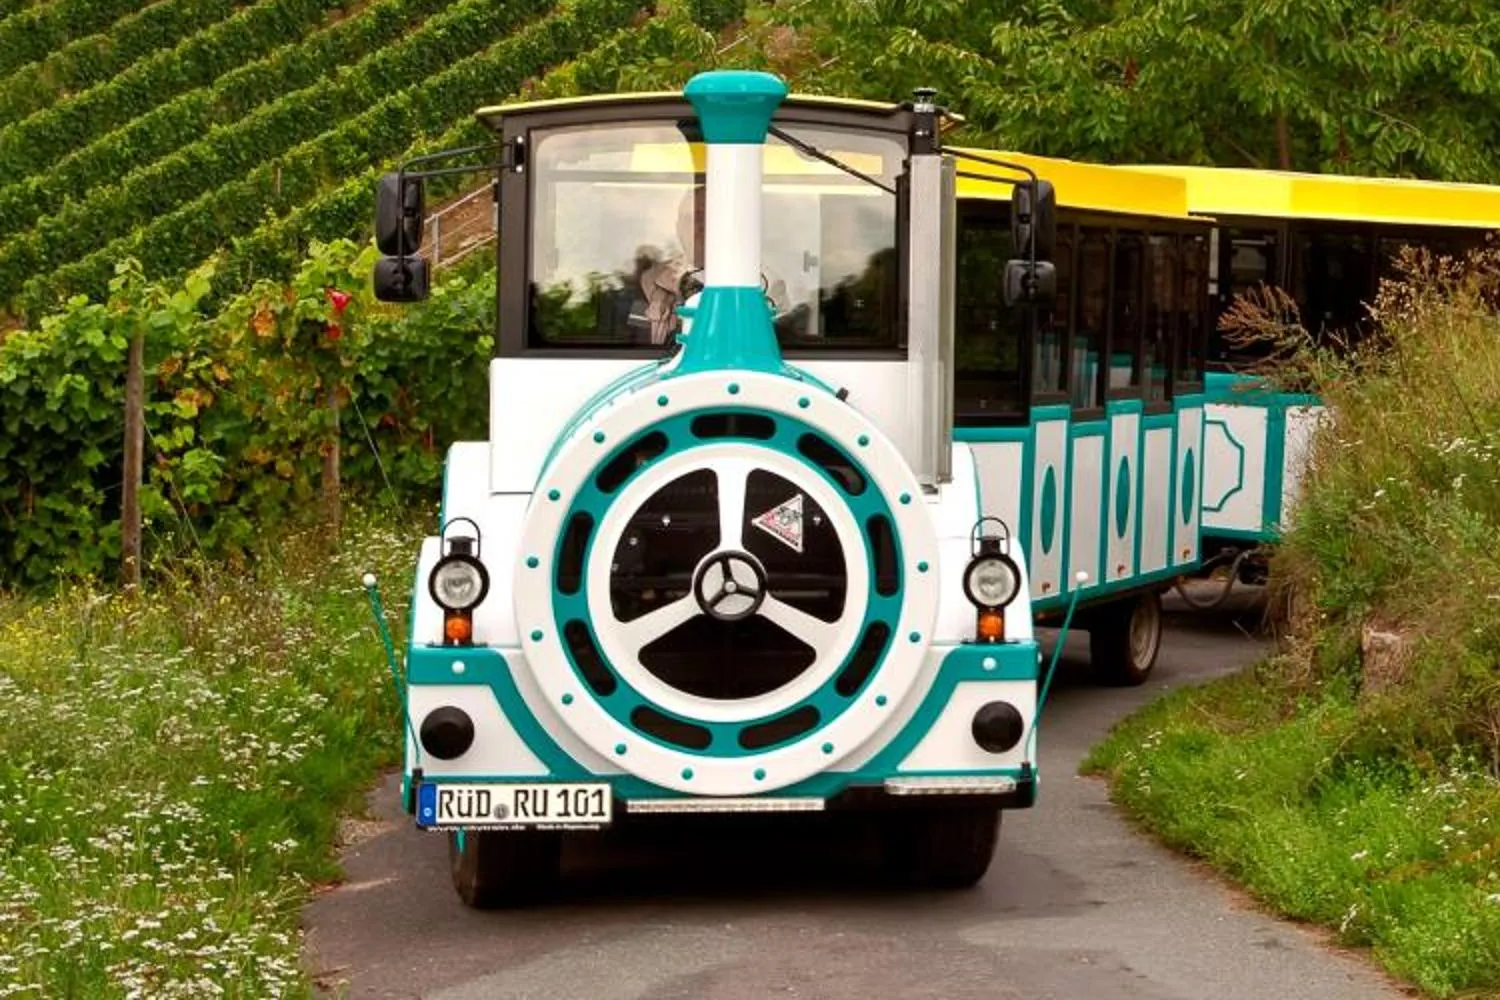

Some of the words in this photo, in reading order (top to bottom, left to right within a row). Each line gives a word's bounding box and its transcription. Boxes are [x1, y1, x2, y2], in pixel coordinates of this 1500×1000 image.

[438, 789, 492, 818] RÜD
[514, 789, 549, 818] RU
[556, 789, 607, 817] 101
